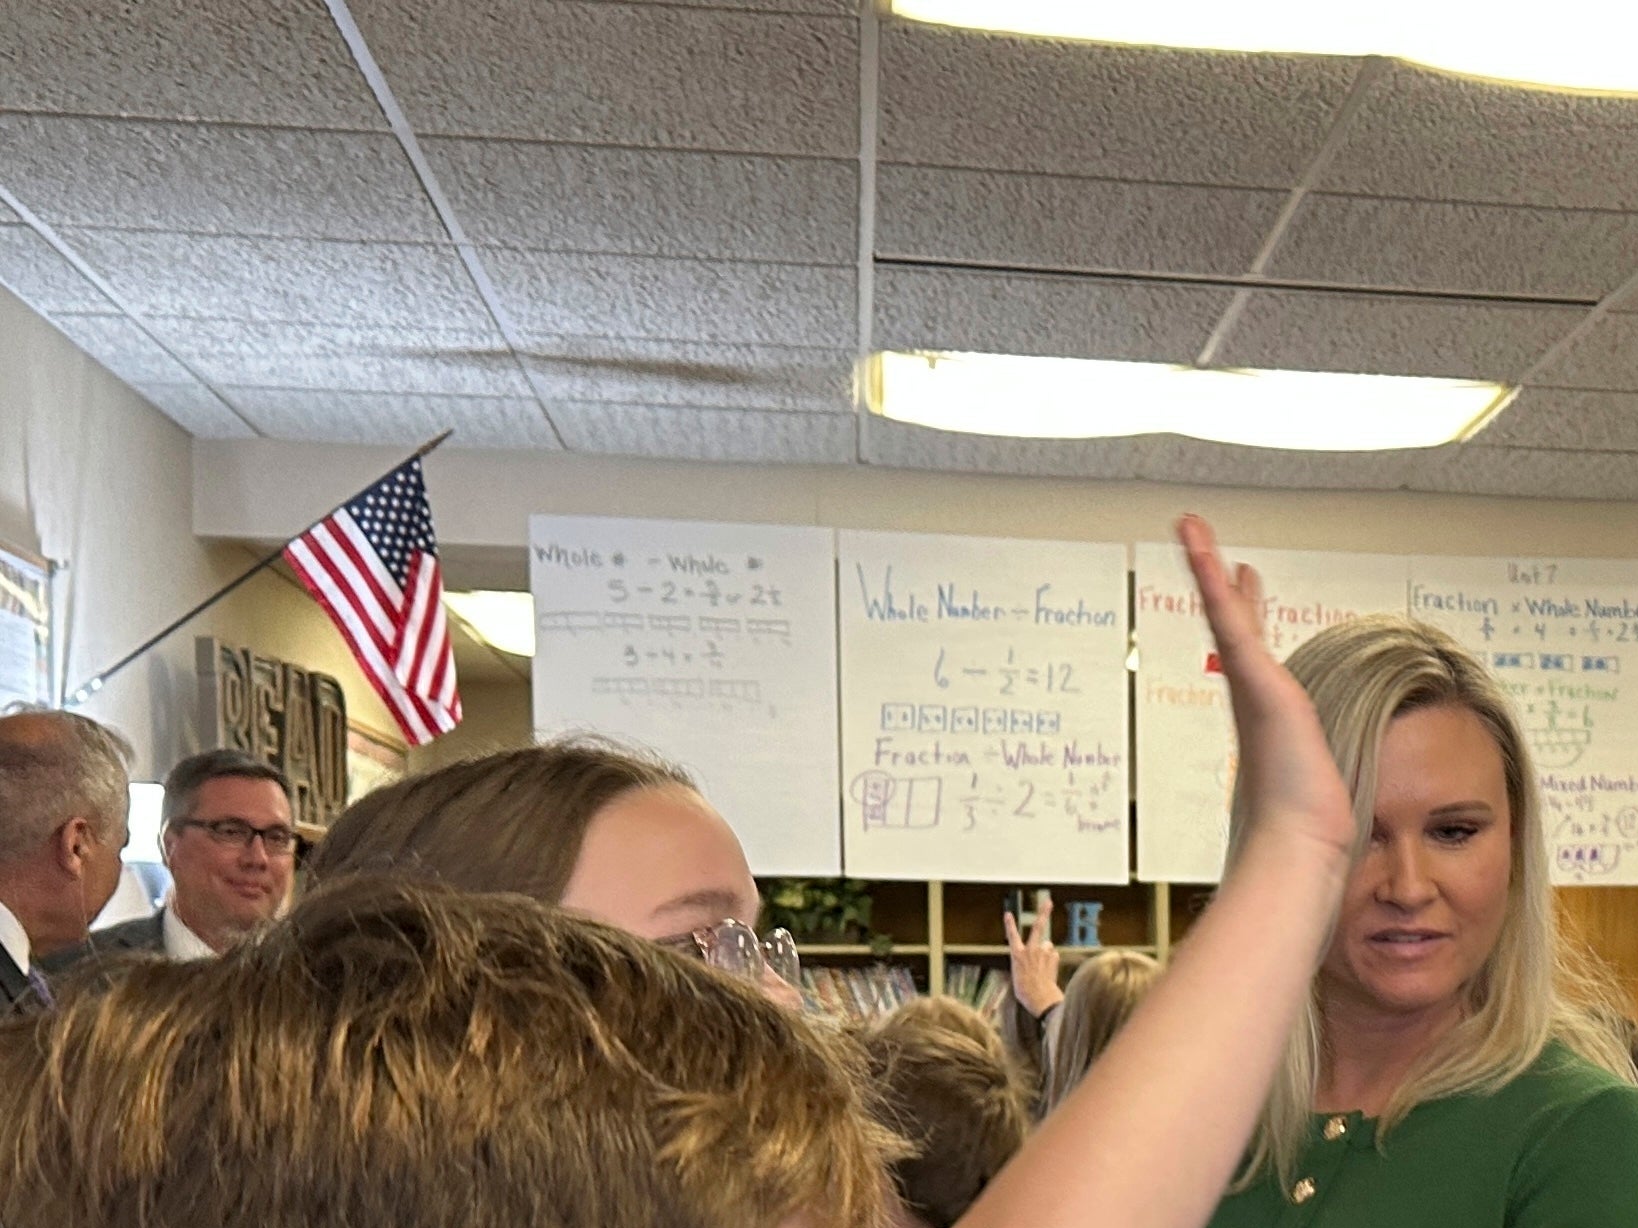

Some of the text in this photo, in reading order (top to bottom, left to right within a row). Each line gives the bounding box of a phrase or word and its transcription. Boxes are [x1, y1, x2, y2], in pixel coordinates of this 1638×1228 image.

[533, 543, 603, 568] Whole
[856, 561, 929, 624] Whole
[937, 582, 1006, 621] Number
[1034, 582, 1117, 626] Fraction
[1412, 584, 1499, 615] Fraction
[1524, 597, 1580, 617] Whole
[934, 646, 950, 689] 6
[1047, 661, 1081, 693] 12
[216, 645, 350, 832] READ
[874, 736, 971, 767] Fraction
[1002, 738, 1054, 770] Whole
[1062, 738, 1122, 769] Number
